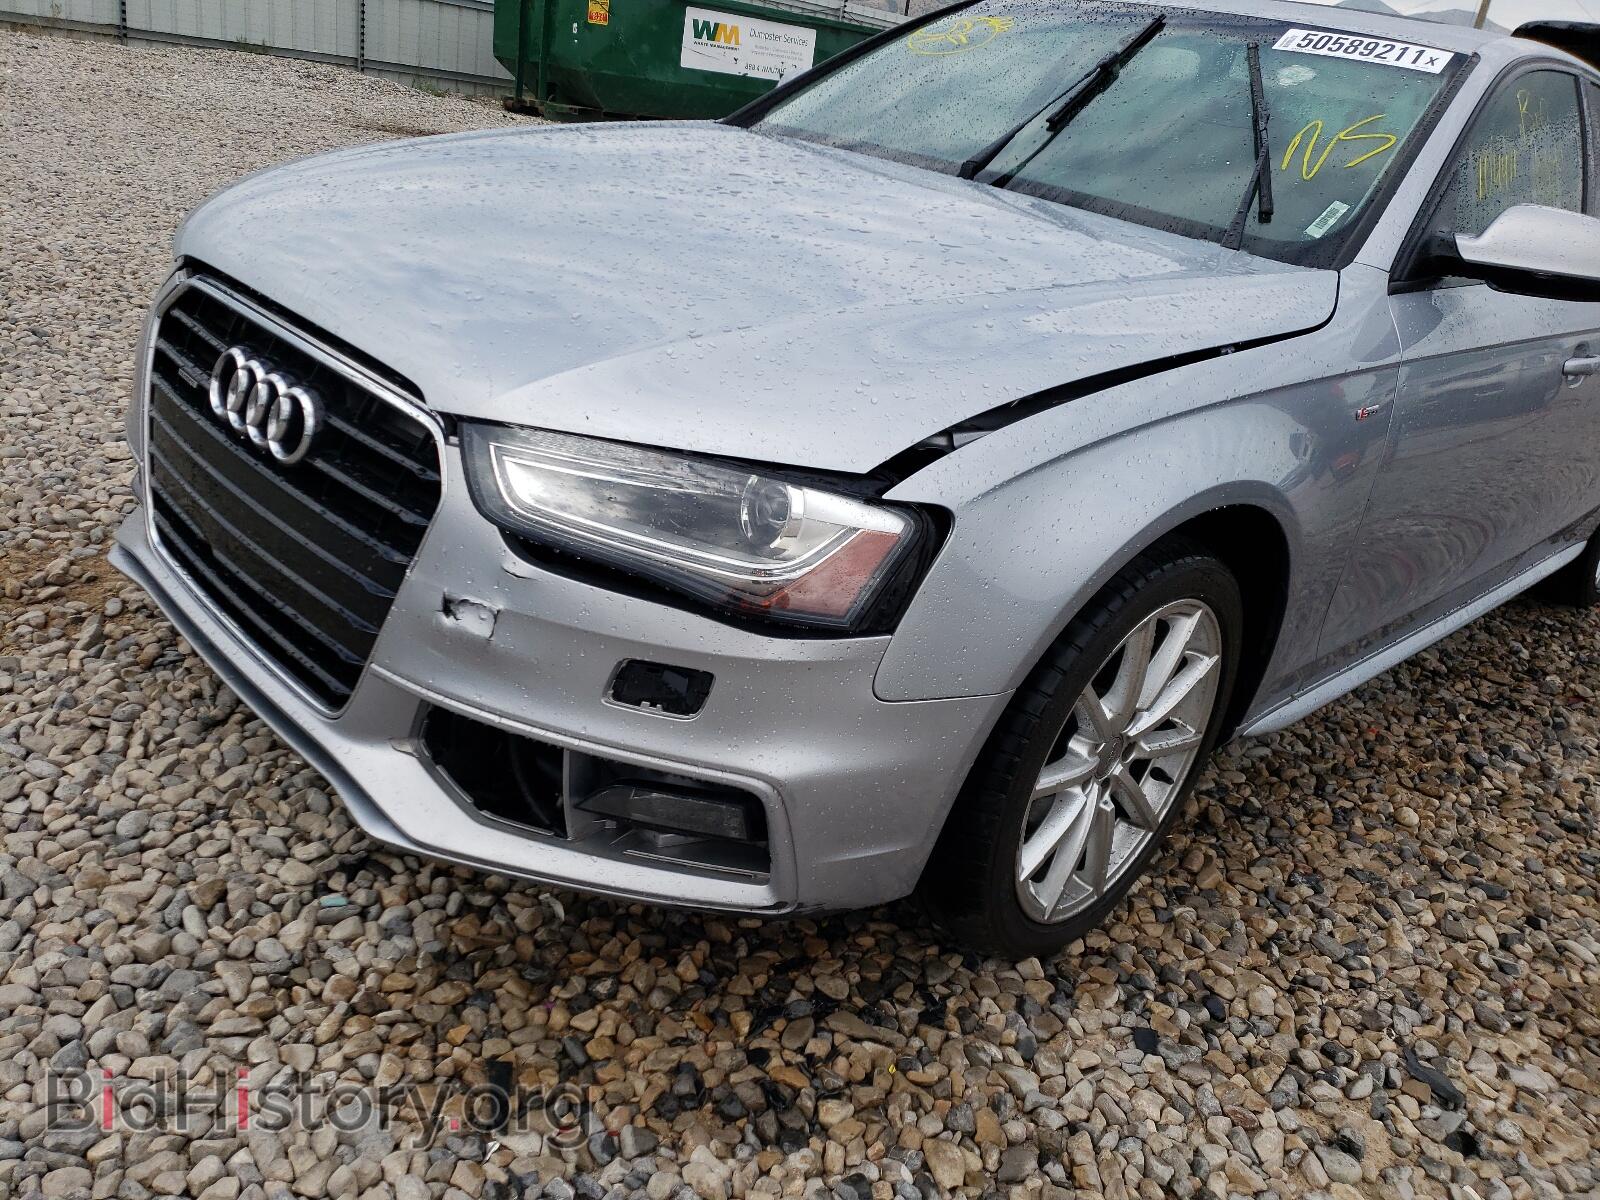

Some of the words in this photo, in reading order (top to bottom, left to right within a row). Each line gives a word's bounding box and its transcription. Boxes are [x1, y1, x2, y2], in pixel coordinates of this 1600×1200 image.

[692, 18, 741, 45] WM
[749, 27, 782, 42] Dumpster
[783, 33, 808, 47] Services
[1281, 114, 1397, 180] NS
